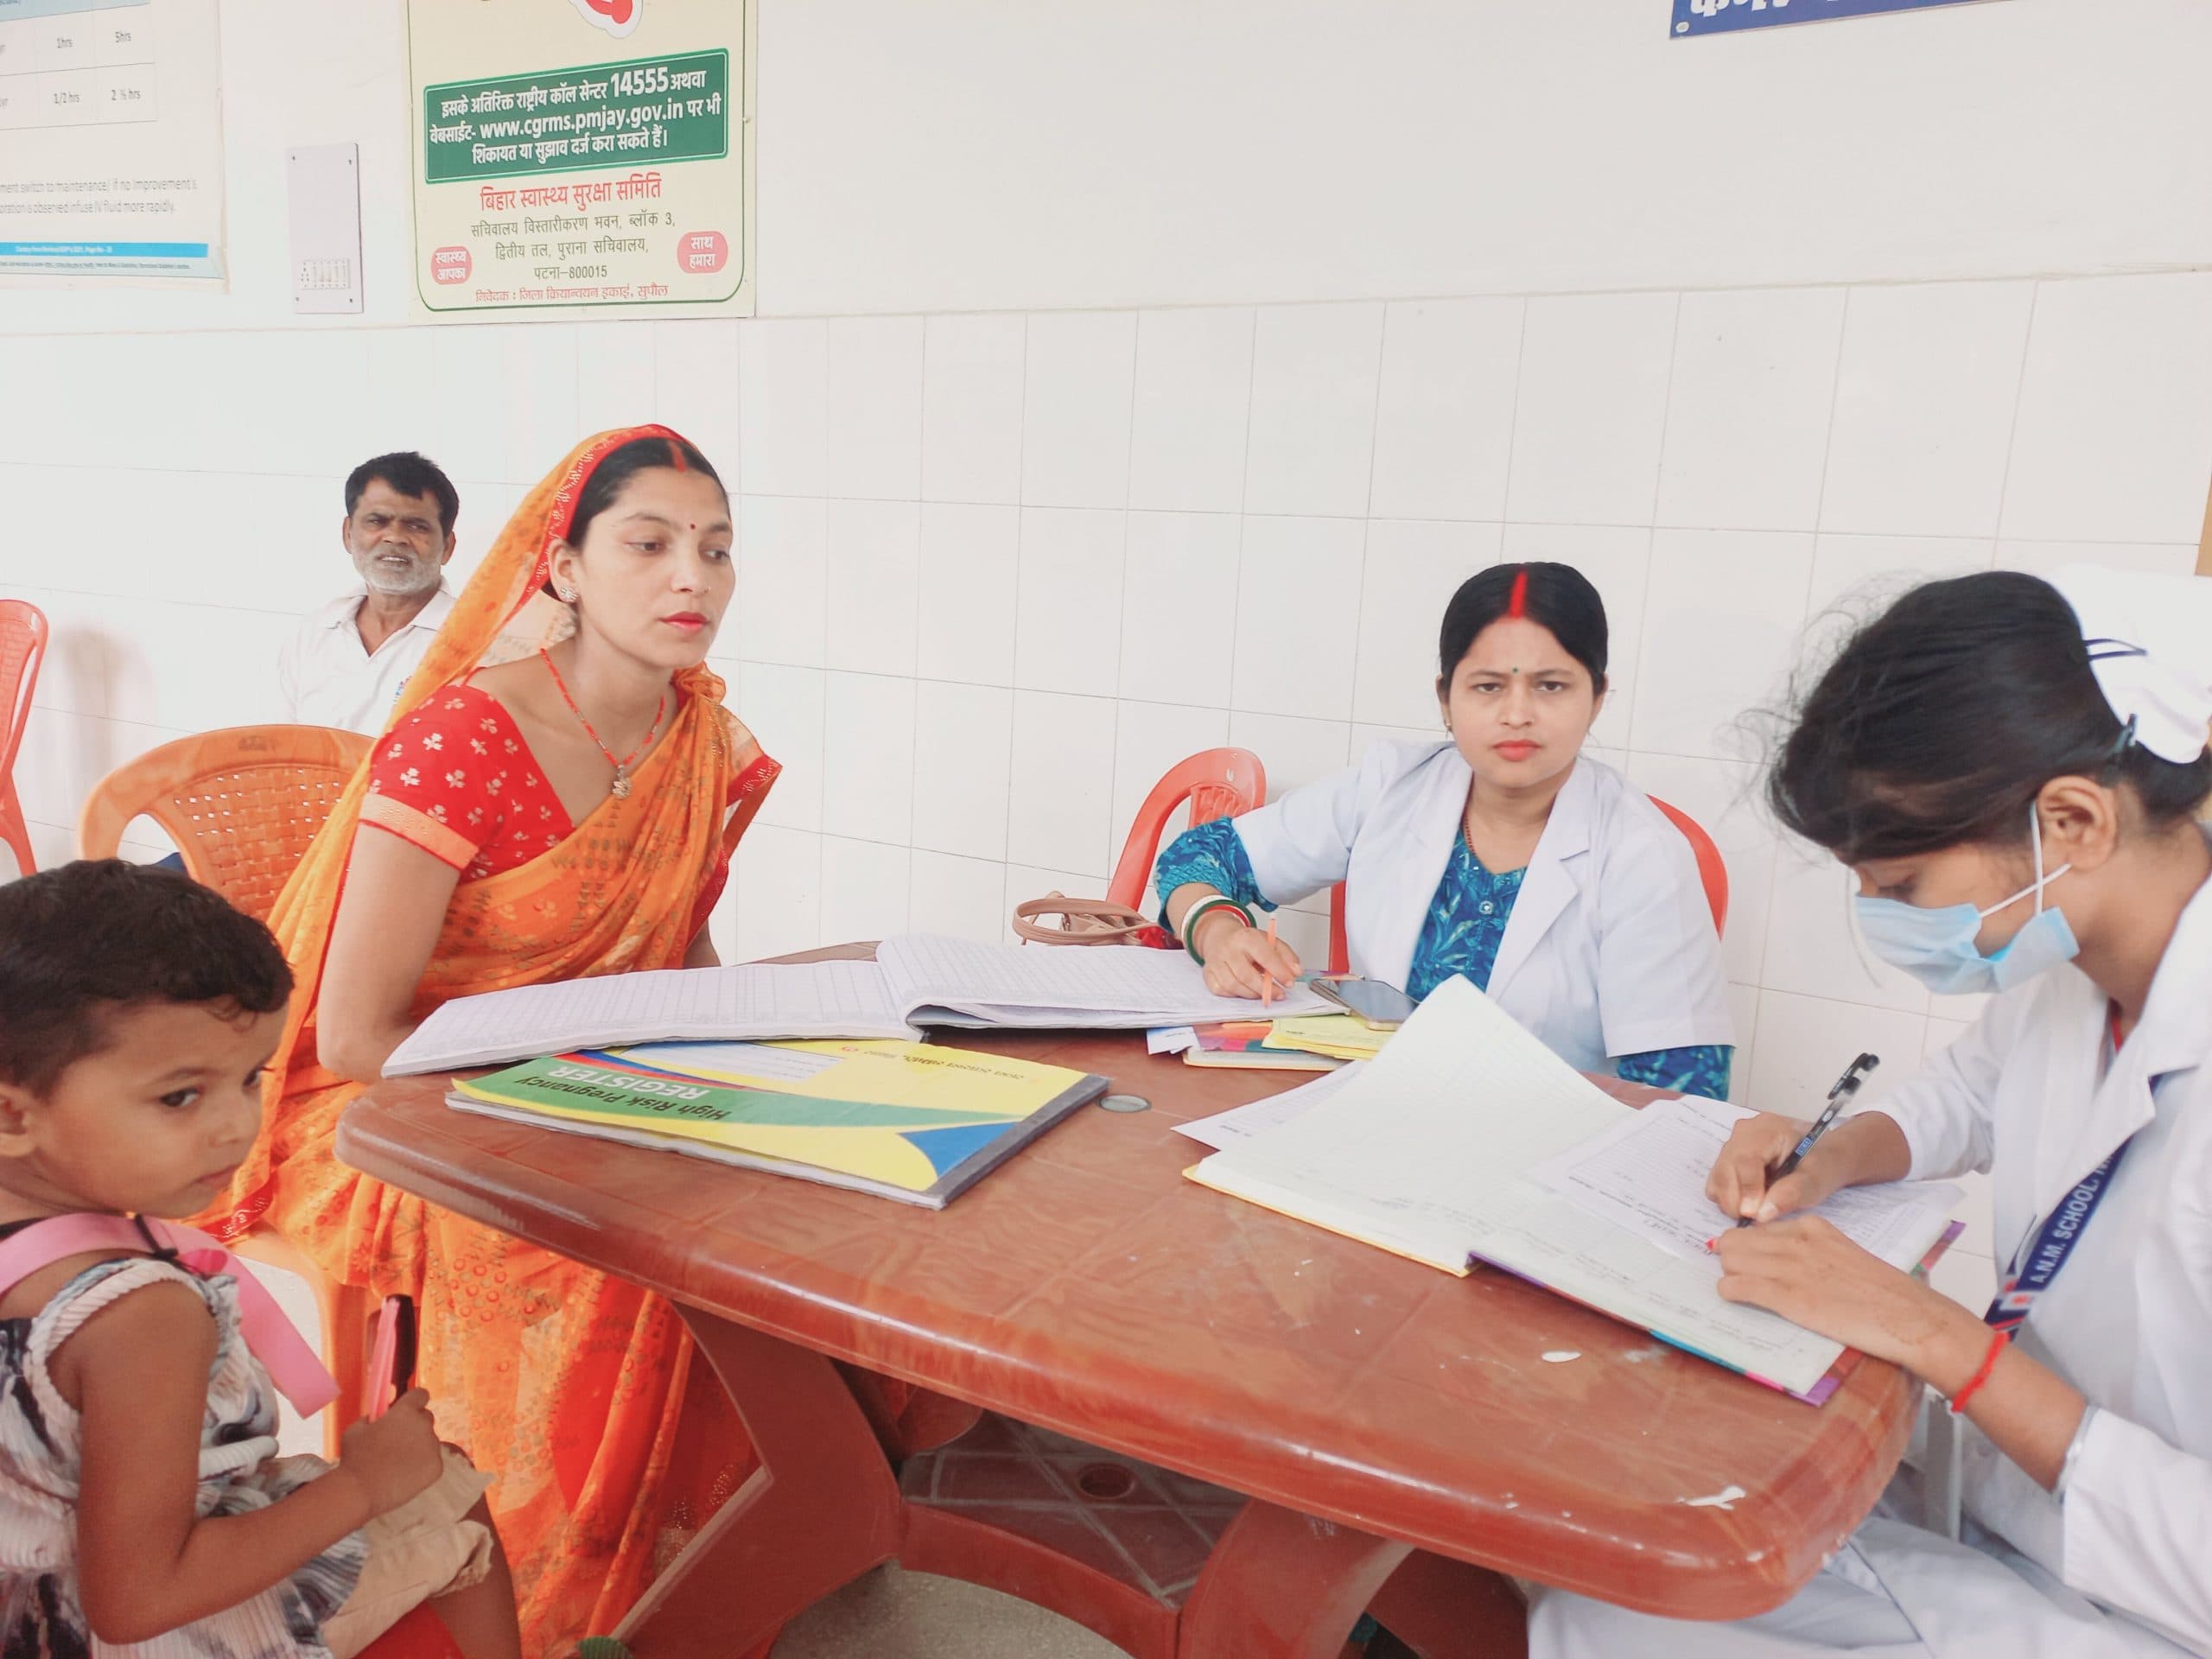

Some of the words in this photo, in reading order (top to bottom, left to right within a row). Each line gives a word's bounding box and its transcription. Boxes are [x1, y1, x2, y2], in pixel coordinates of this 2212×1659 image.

[442, 94, 468, 118] इसके
[470, 91, 514, 113] अतिरिक्त
[516, 86, 548, 111] राष्ट्रीय
[550, 82, 577, 104] कॉल
[579, 79, 607, 101] सेन्टर
[611, 67, 669, 97] 14555
[671, 70, 707, 90] अथवा
[480, 98, 683, 138] www.cgrms.pmjay.gov.in
[686, 99, 704, 117] पर
[706, 92, 721, 115] भी
[472, 143, 518, 164] शिकायत
[518, 143, 533, 159] या
[535, 139, 569, 164] सुझाव
[570, 131, 589, 155] दर्ज
[592, 134, 615, 152] करा
[617, 126, 649, 151] सकते
[480, 186, 516, 211] बिहार
[519, 185, 569, 208] स्वास्थ्य
[572, 182, 612, 211] सुरक्षा
[616, 172, 662, 200] समिति
[471, 220, 518, 238] सचिवालय
[524, 215, 588, 235] विस्तारीकरण
[629, 209, 658, 227] ब्लॉक
[496, 242, 525, 260] द्वितीय
[557, 241, 587, 260] पुराना
[691, 236, 714, 250] साथ
[476, 289, 509, 302] निवेदक
[519, 288, 543, 301] जिला
[516, 1076, 627, 1103] Pregnancy
[547, 1065, 711, 1100] REGISTER
[626, 1096, 678, 1112] Risk
[677, 1105, 733, 1121] High
